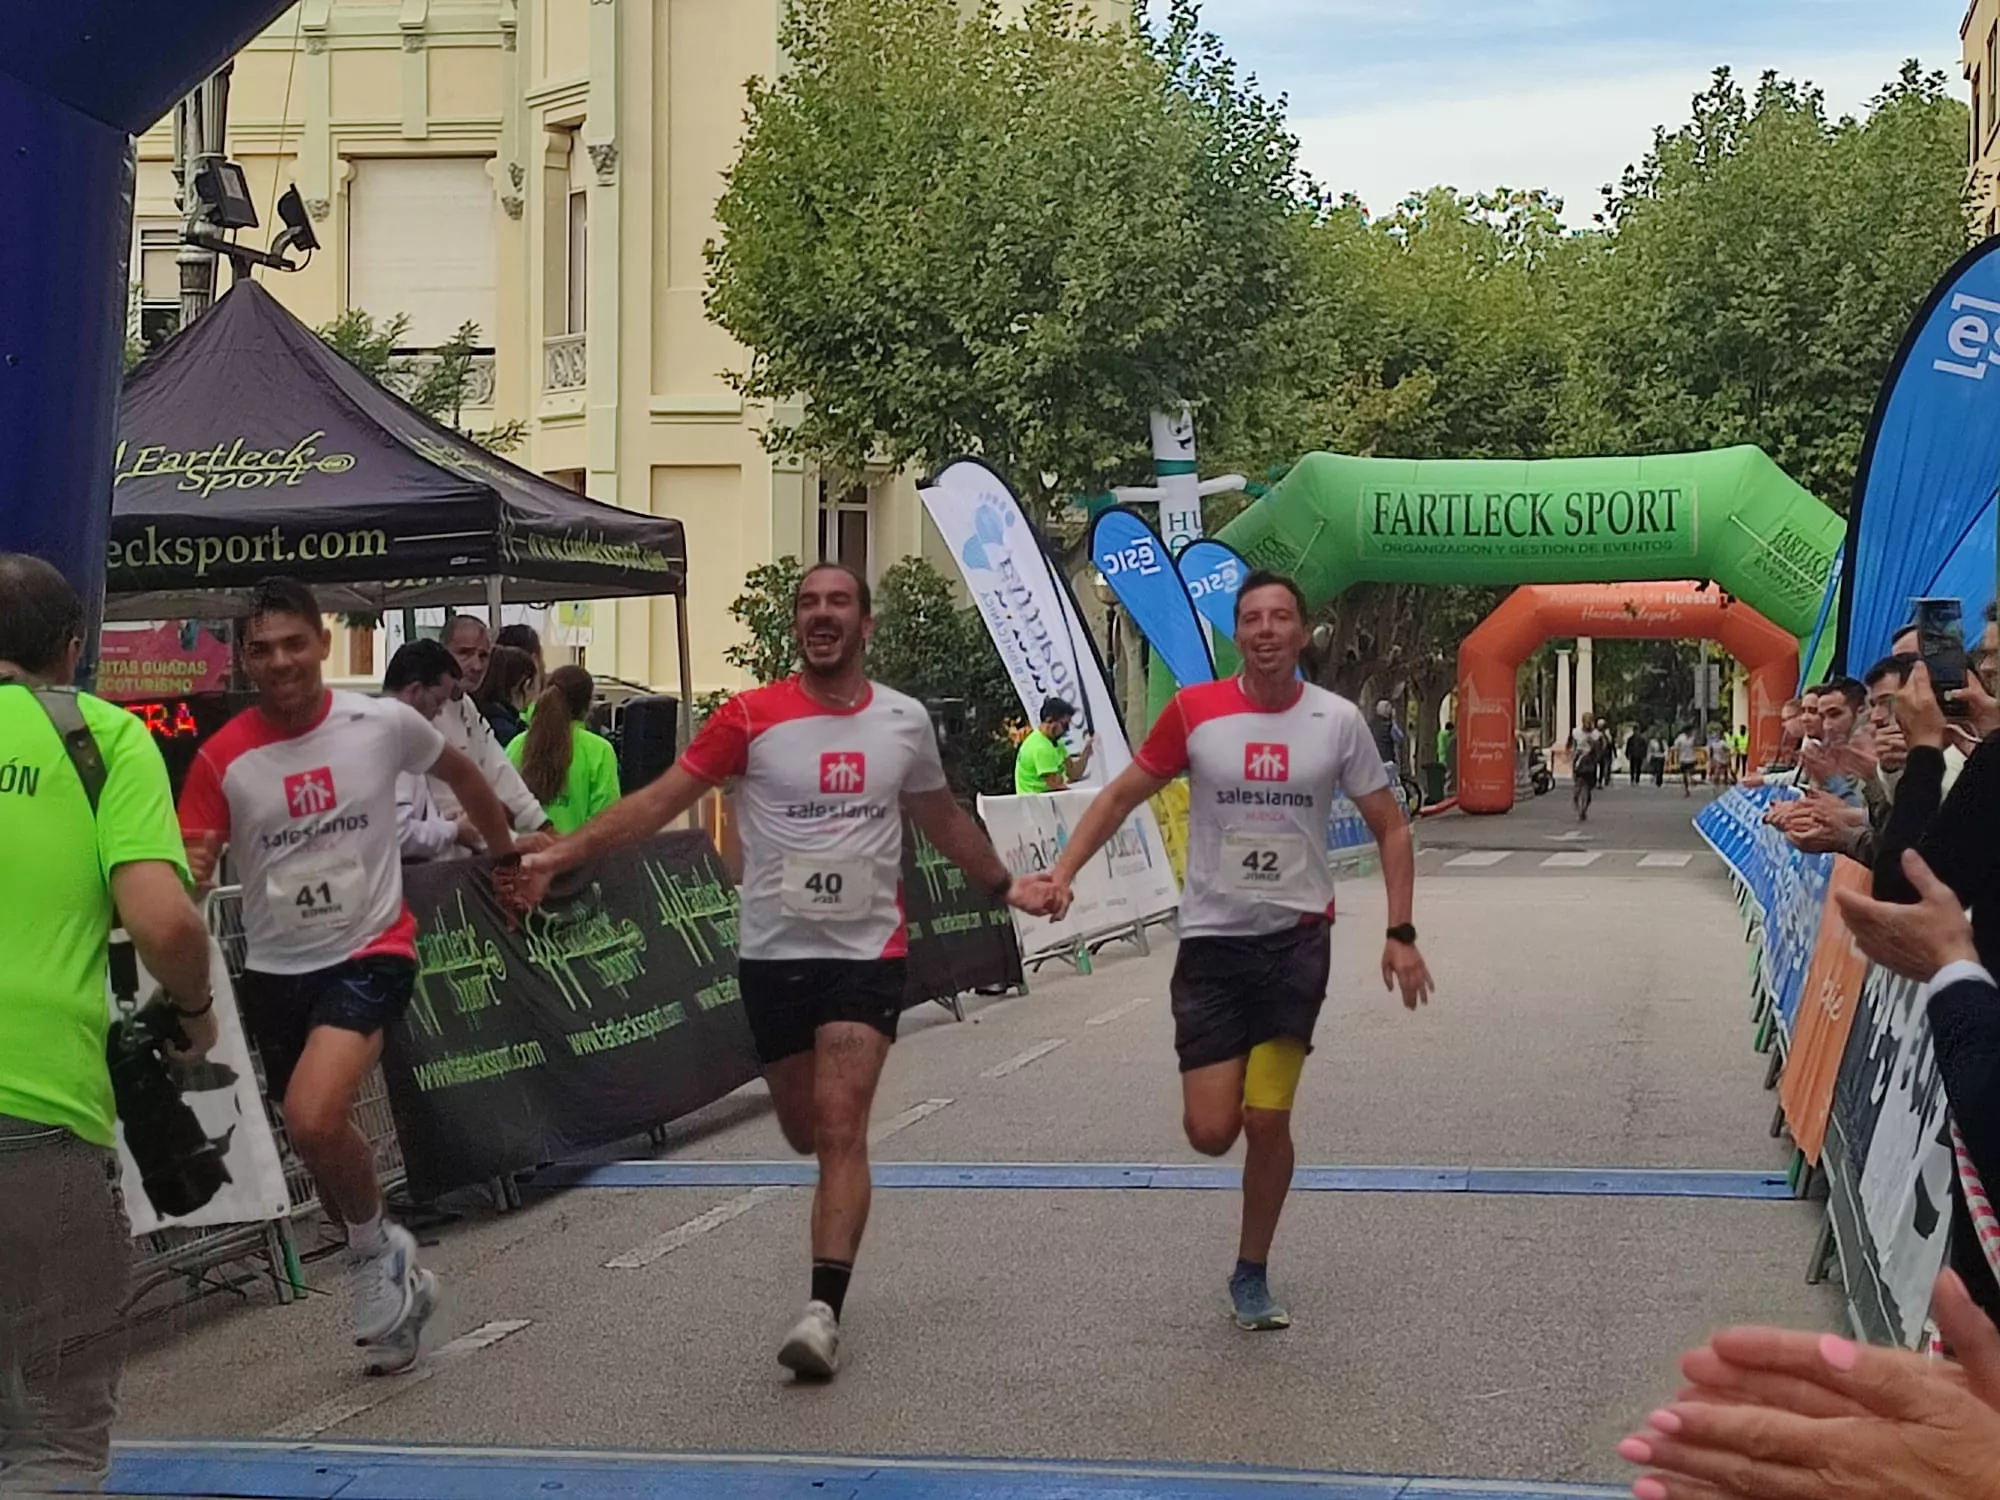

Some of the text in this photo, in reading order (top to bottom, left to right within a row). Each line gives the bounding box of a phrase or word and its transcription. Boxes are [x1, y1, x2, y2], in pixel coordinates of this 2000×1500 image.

[177, 465, 304, 498] Sport
[1372, 488, 1682, 538] FARTLECK SPORT
[107, 525, 388, 577] ecksport.com
[1666, 591, 1717, 604] Huesca
[125, 702, 198, 738] RA
[1216, 787, 1314, 808] salesianos
[1242, 851, 1279, 872] 42
[295, 882, 332, 907] 41
[805, 872, 843, 895] 40
